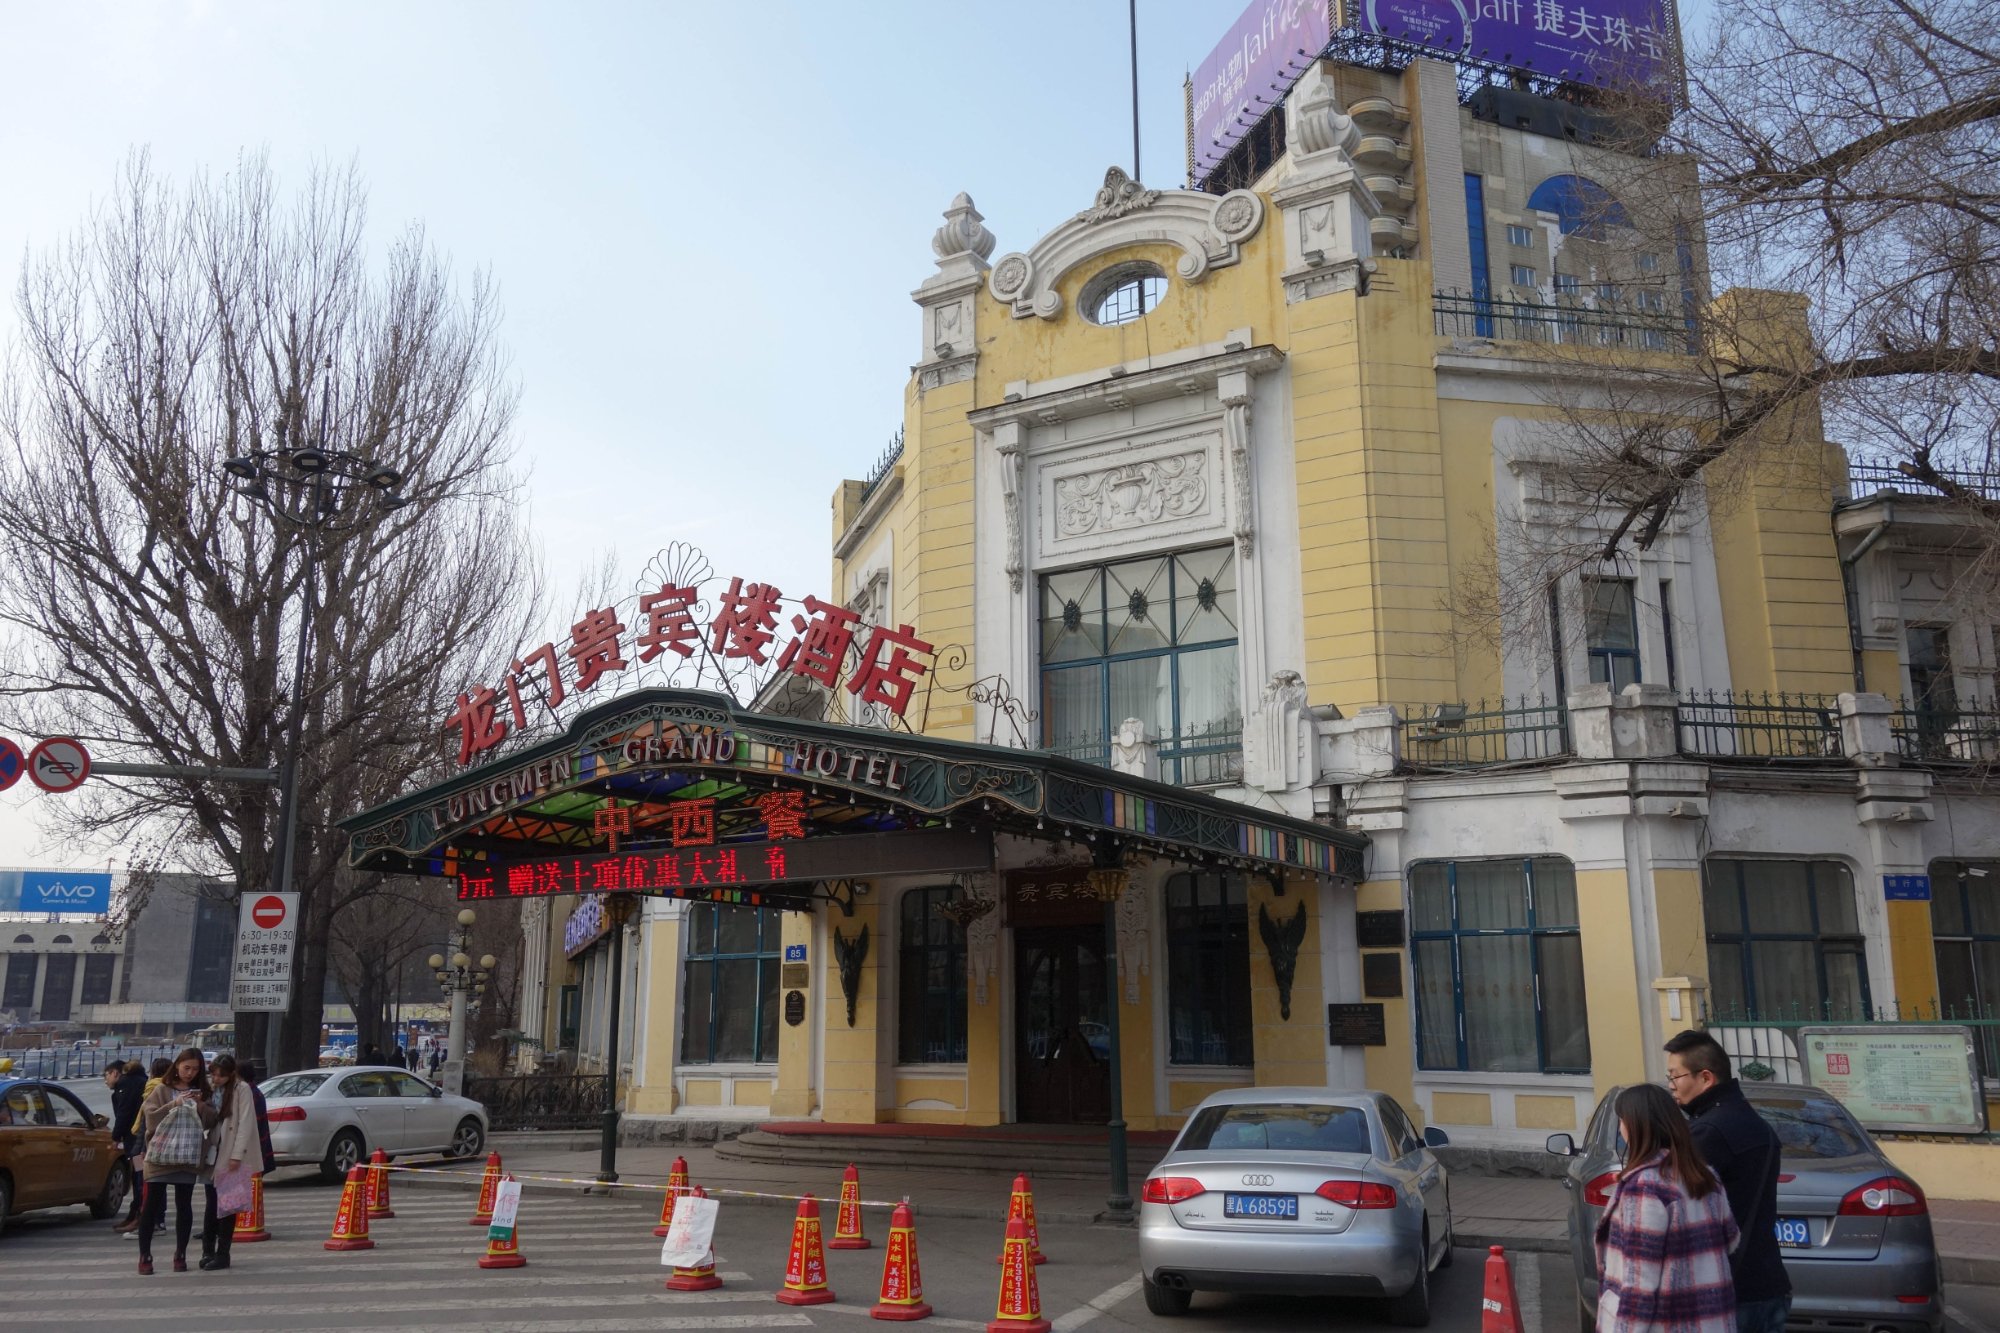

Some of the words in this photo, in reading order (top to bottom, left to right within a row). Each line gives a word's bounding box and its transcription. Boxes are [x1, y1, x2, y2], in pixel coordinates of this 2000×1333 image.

[1533, 0, 1670, 62] 捷夫珠宝
[446, 576, 935, 766] 龙门贵宾楼酒店
[432, 753, 573, 832] LONGMEN
[622, 730, 737, 766] GRAND
[791, 740, 908, 791] HOTEL
[594, 790, 807, 854] 中西餐
[37, 882, 96, 897] vivo
[241, 931, 293, 940] 6:30-19:30
[242, 944, 287, 955] 机动车号牌
[790, 949, 801, 957] 85
[237, 963, 249, 973] 尾号
[275, 963, 288, 973] 通行
[72, 1148, 95, 1162] TAXI
[807, 1222, 822, 1284] 潜水艇地漏
[1005, 1245, 1014, 1313] 施工改造热线
